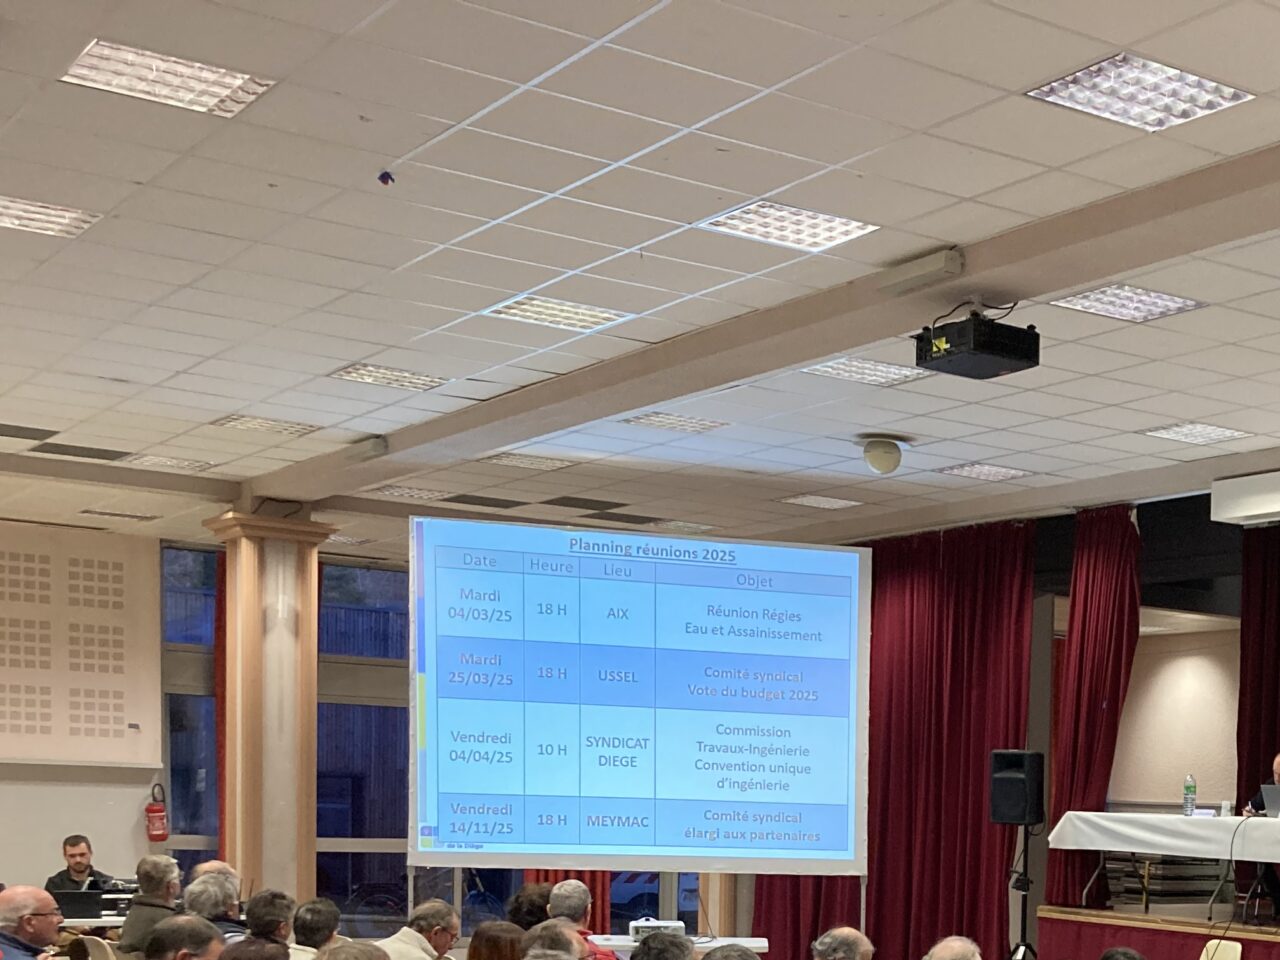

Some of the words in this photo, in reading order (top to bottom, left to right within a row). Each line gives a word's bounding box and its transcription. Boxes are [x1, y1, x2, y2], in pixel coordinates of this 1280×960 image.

[569, 537, 633, 557] Planning
[636, 543, 698, 560] réunions
[702, 549, 737, 563] 2025
[463, 553, 497, 567] Date
[530, 559, 574, 573] Heure
[603, 563, 632, 577] Lieu
[736, 574, 773, 589] Objet
[460, 588, 501, 602] Mardi
[447, 606, 512, 623] 04/03/25
[537, 602, 554, 615] 18
[557, 604, 567, 616] H
[606, 608, 629, 620] AIX
[707, 605, 759, 620] Réunion
[762, 609, 802, 624] Régies
[685, 622, 708, 635] Eau
[711, 625, 724, 636] et
[727, 625, 823, 642] Assainissement
[460, 653, 502, 666] Mardi
[448, 672, 513, 687] 25/03/25
[537, 667, 554, 679] 18
[557, 668, 567, 680] H
[598, 670, 639, 683] USSEL
[704, 666, 750, 680] Comité
[753, 670, 803, 684] syndical
[688, 684, 716, 696] Vote
[721, 685, 737, 697] du
[741, 685, 785, 701] budget
[789, 690, 819, 701] 2025
[450, 730, 512, 745] Vendredi
[716, 723, 791, 738] Commission
[537, 744, 554, 755] 10
[557, 744, 567, 756] H
[586, 736, 650, 750] SYNDICAT
[696, 741, 810, 757] Travaux-Ingénierie
[449, 750, 513, 764] 04/04/25
[598, 755, 638, 768] DIEGE
[695, 759, 765, 773] Convention
[769, 763, 811, 776] unique
[717, 777, 790, 792] d'ingénierie
[450, 803, 513, 816] Vendredi
[537, 814, 554, 826] 18
[557, 814, 567, 826] H
[586, 815, 649, 828] MEYMAC
[704, 809, 749, 822] Comité
[752, 812, 802, 825] syndical
[449, 821, 513, 836] 14/11/25
[684, 826, 720, 841] élargi
[724, 831, 746, 841] aux
[750, 830, 820, 843] partenaires
